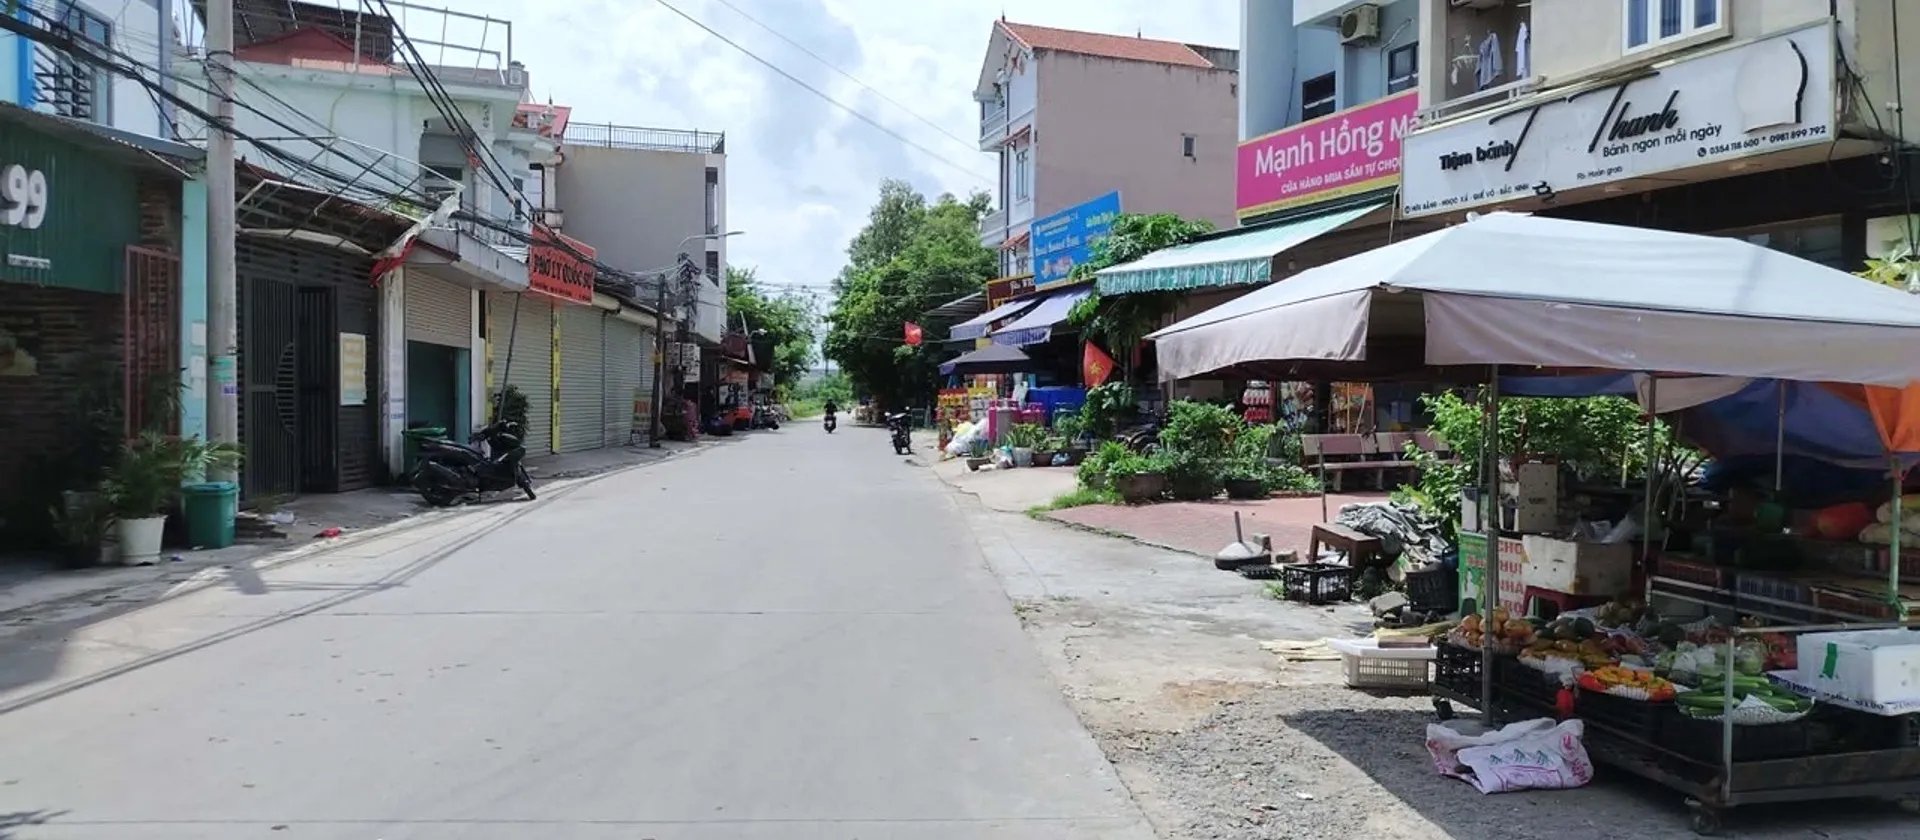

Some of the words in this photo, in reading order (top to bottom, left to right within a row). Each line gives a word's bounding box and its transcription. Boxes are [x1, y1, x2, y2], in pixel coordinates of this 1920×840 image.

[1602, 139, 1630, 158] Bánh
[1632, 136, 1661, 154] ngon
[1664, 127, 1687, 146] mỗi
[1690, 123, 1722, 144] ngày
[1808, 125, 1827, 136] 792
[1255, 133, 1315, 178] Mạnh
[1319, 119, 1384, 161] Hồng
[1439, 151, 1473, 170] Tiệm
[1475, 139, 1516, 162] bánh
[1299, 175, 1323, 190] HÀNG
[1324, 171, 1343, 185] MUA
